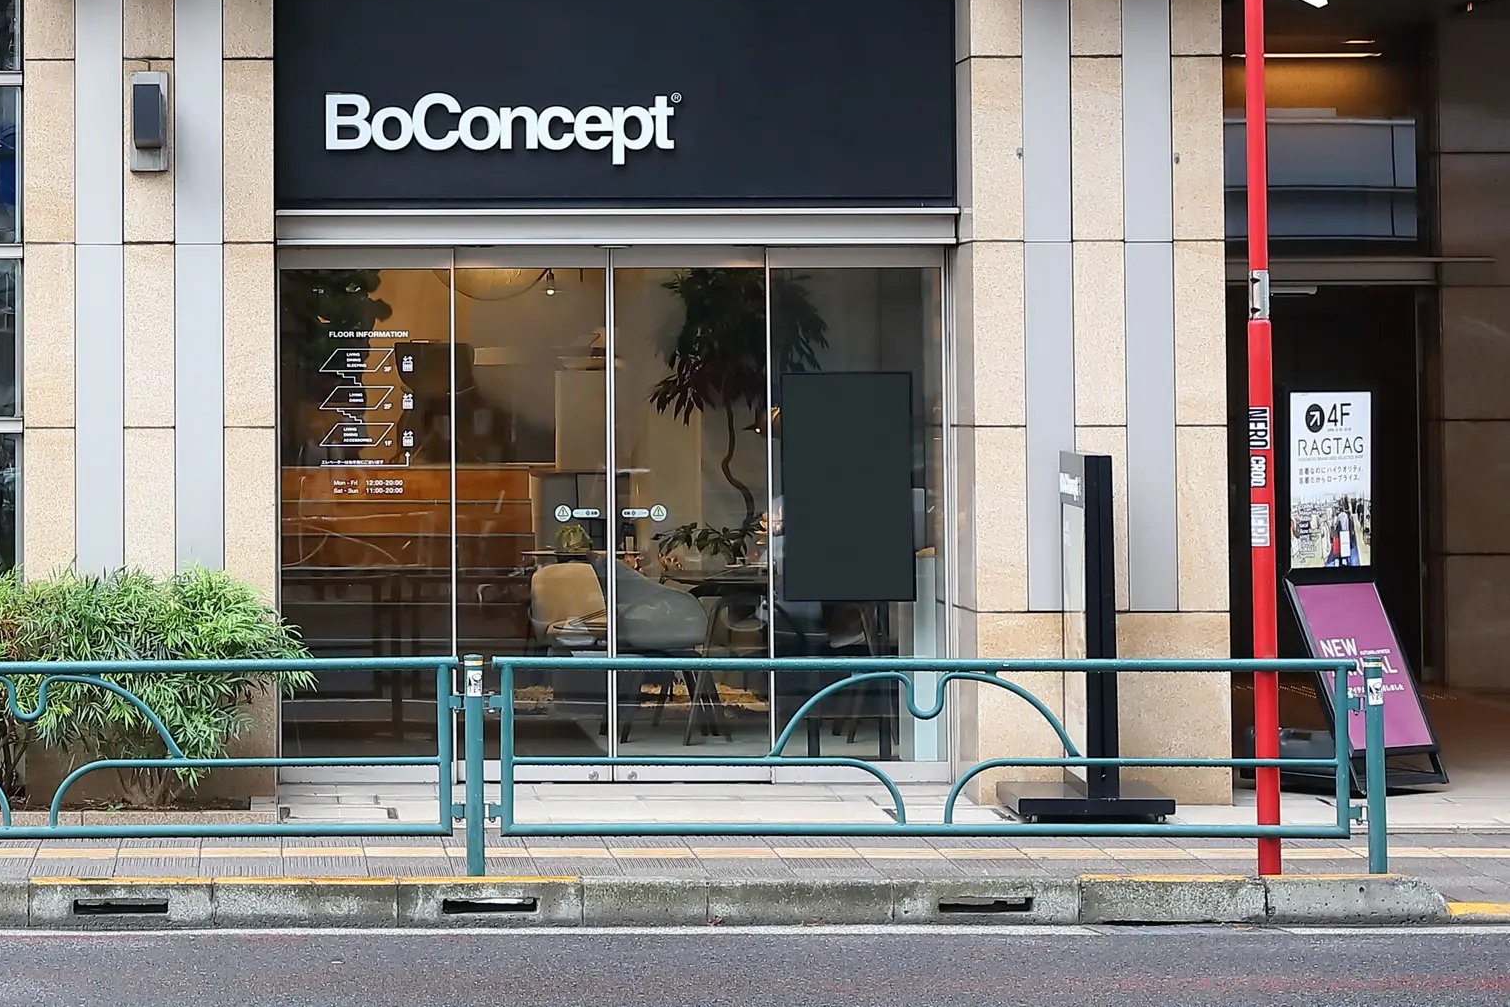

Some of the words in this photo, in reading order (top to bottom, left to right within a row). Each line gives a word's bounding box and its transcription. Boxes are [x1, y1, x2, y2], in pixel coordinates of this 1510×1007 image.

[1327, 402, 1352, 427] 4F
[1249, 407, 1268, 449] NERO
[1297, 436, 1364, 457] RAGTAG
[1319, 638, 1357, 658] NEW
